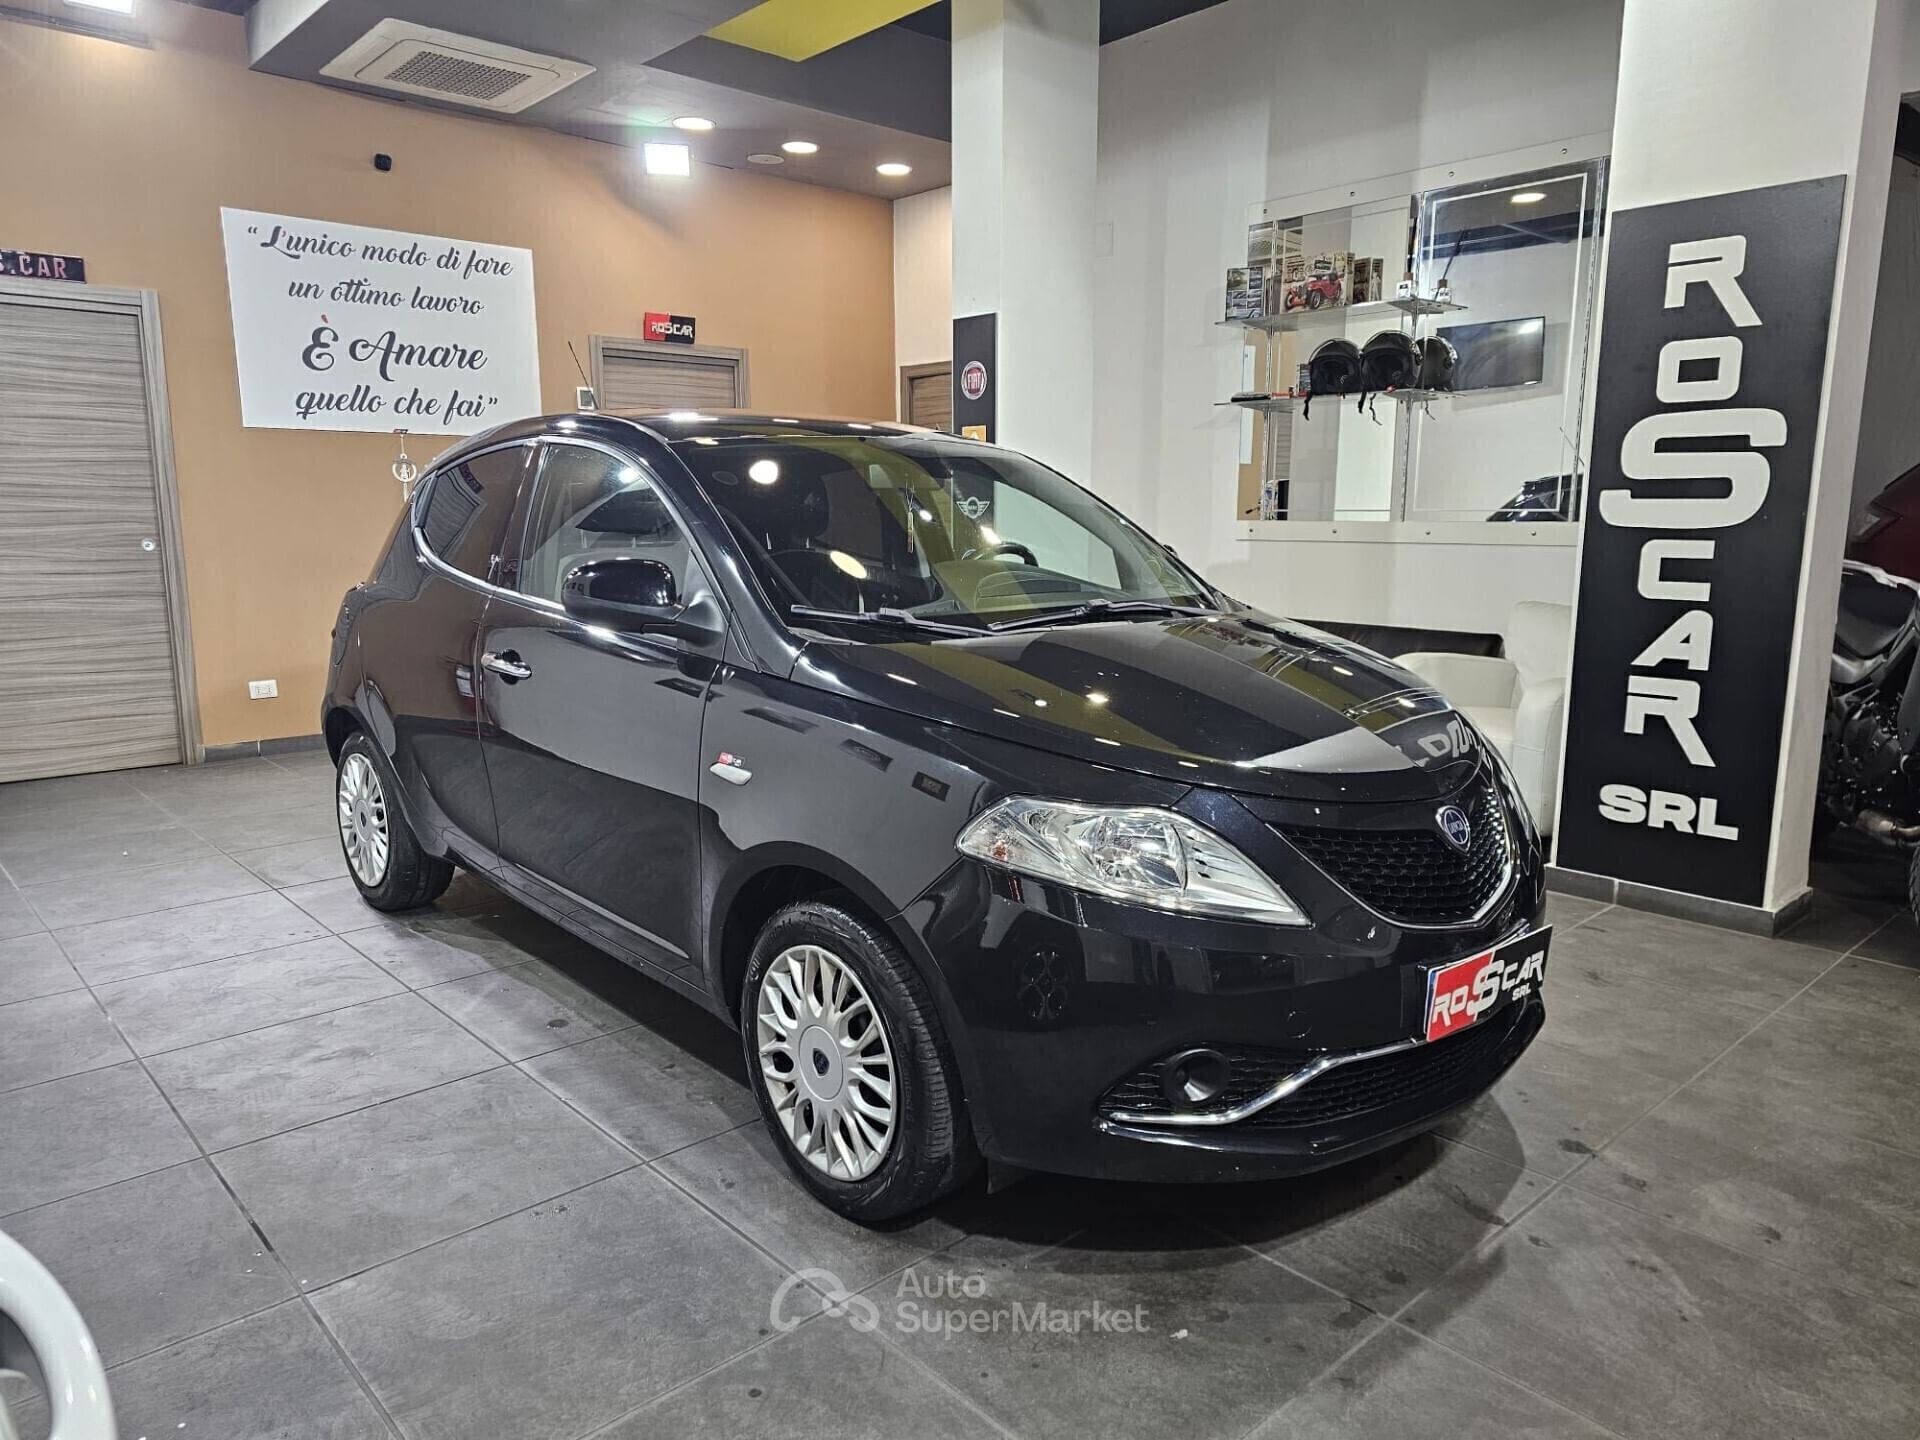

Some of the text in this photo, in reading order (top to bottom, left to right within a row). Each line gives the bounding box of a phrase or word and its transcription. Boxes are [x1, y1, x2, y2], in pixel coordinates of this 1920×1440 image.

[361, 242, 431, 267] modo
[436, 247, 461, 270] di
[463, 250, 513, 280] fare
[288, 277, 484, 315] un ottimo lavoro
[302, 314, 488, 382] È Amare
[295, 384, 386, 420] quello
[393, 387, 440, 416] che
[1599, 783, 1739, 842] SRL
[1512, 983, 1531, 1001] SRL
